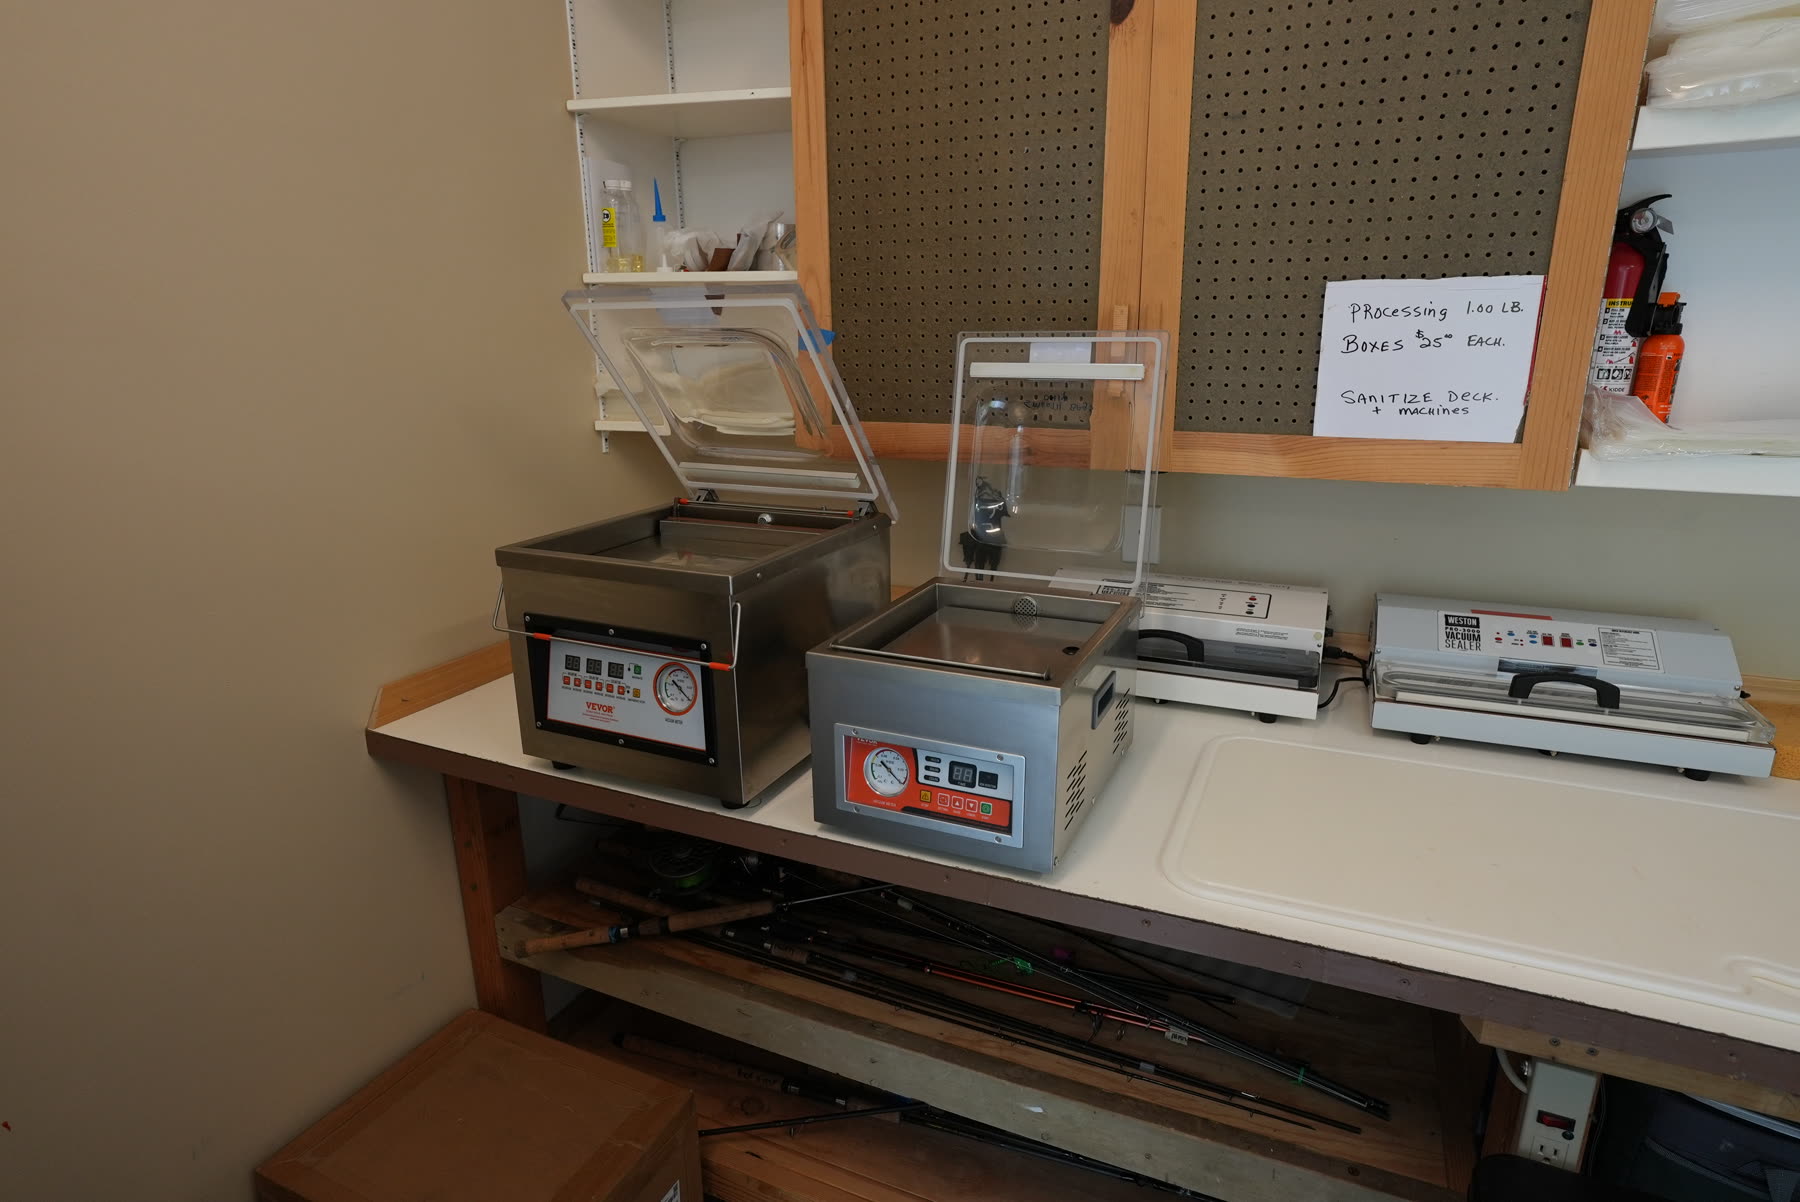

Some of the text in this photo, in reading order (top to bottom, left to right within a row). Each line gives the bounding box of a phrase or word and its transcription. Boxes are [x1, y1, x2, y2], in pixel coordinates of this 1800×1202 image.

[1466, 301, 1493, 314] 1.00
[1501, 301, 1524, 313] LB.
[1341, 334, 1404, 354] BOXES
[1467, 334, 1505, 347] EACH.
[1372, 406, 1382, 415] +
[1447, 616, 1478, 626] WESTON
[1445, 631, 1481, 642] VACUUM
[1444, 638, 1482, 651] SEALER
[585, 701, 614, 714] VEVOR
